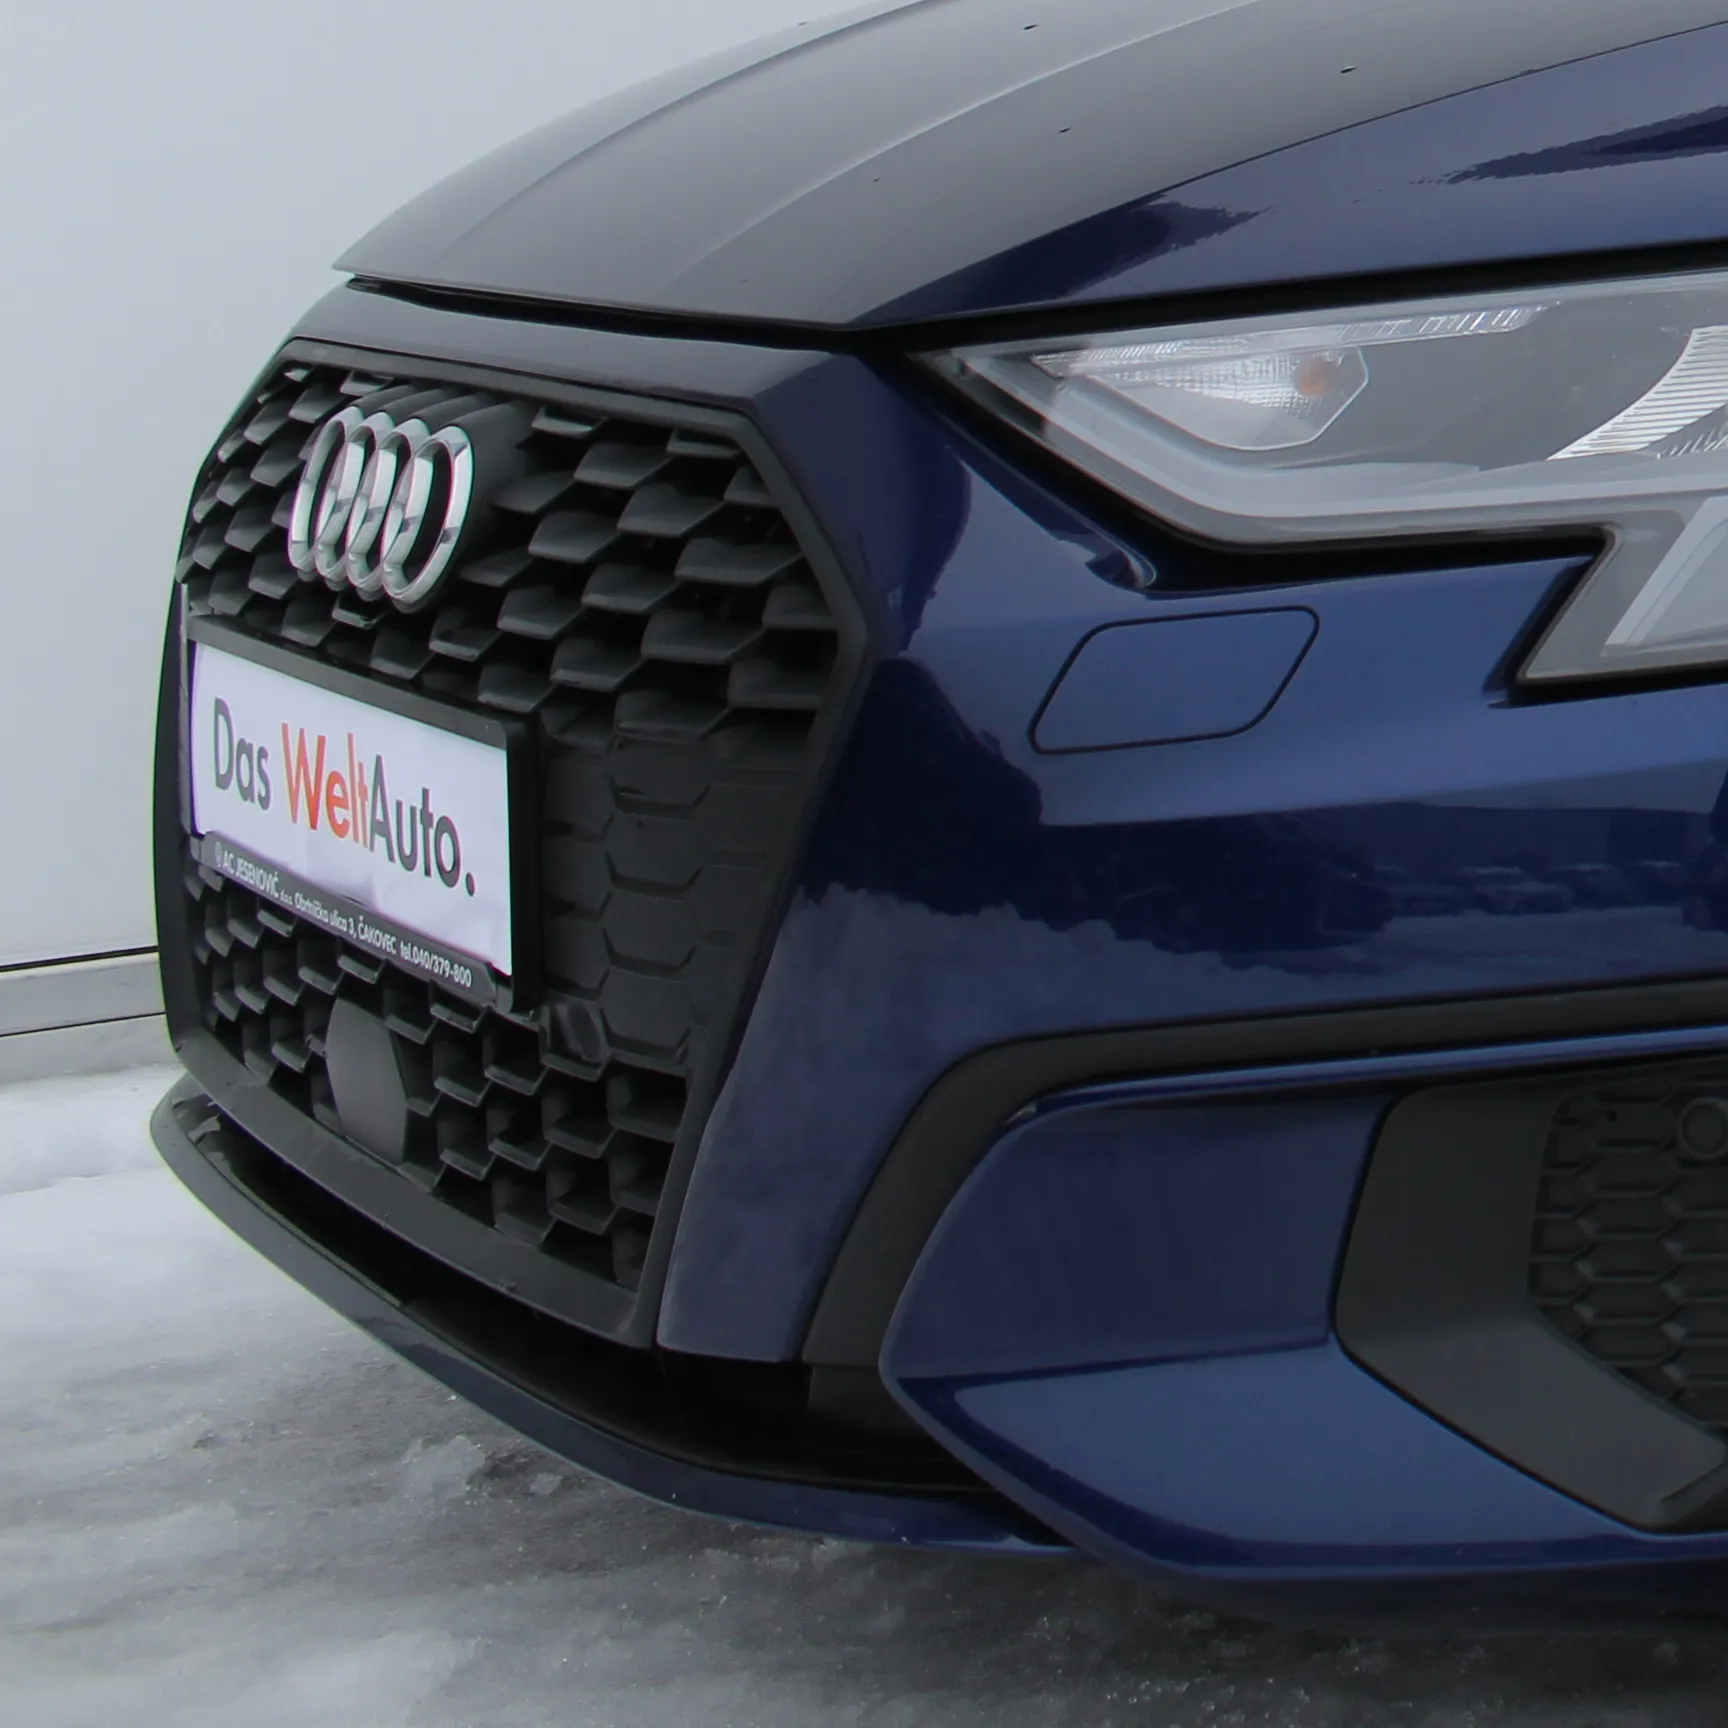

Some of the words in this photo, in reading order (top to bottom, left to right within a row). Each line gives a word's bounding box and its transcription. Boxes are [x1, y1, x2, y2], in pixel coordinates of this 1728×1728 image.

[213, 696, 271, 812] Das
[281, 721, 477, 897] WeltAuto.
[236, 857, 279, 898] JESENOVIĆ
[358, 915, 397, 954] ČAKOVEC
